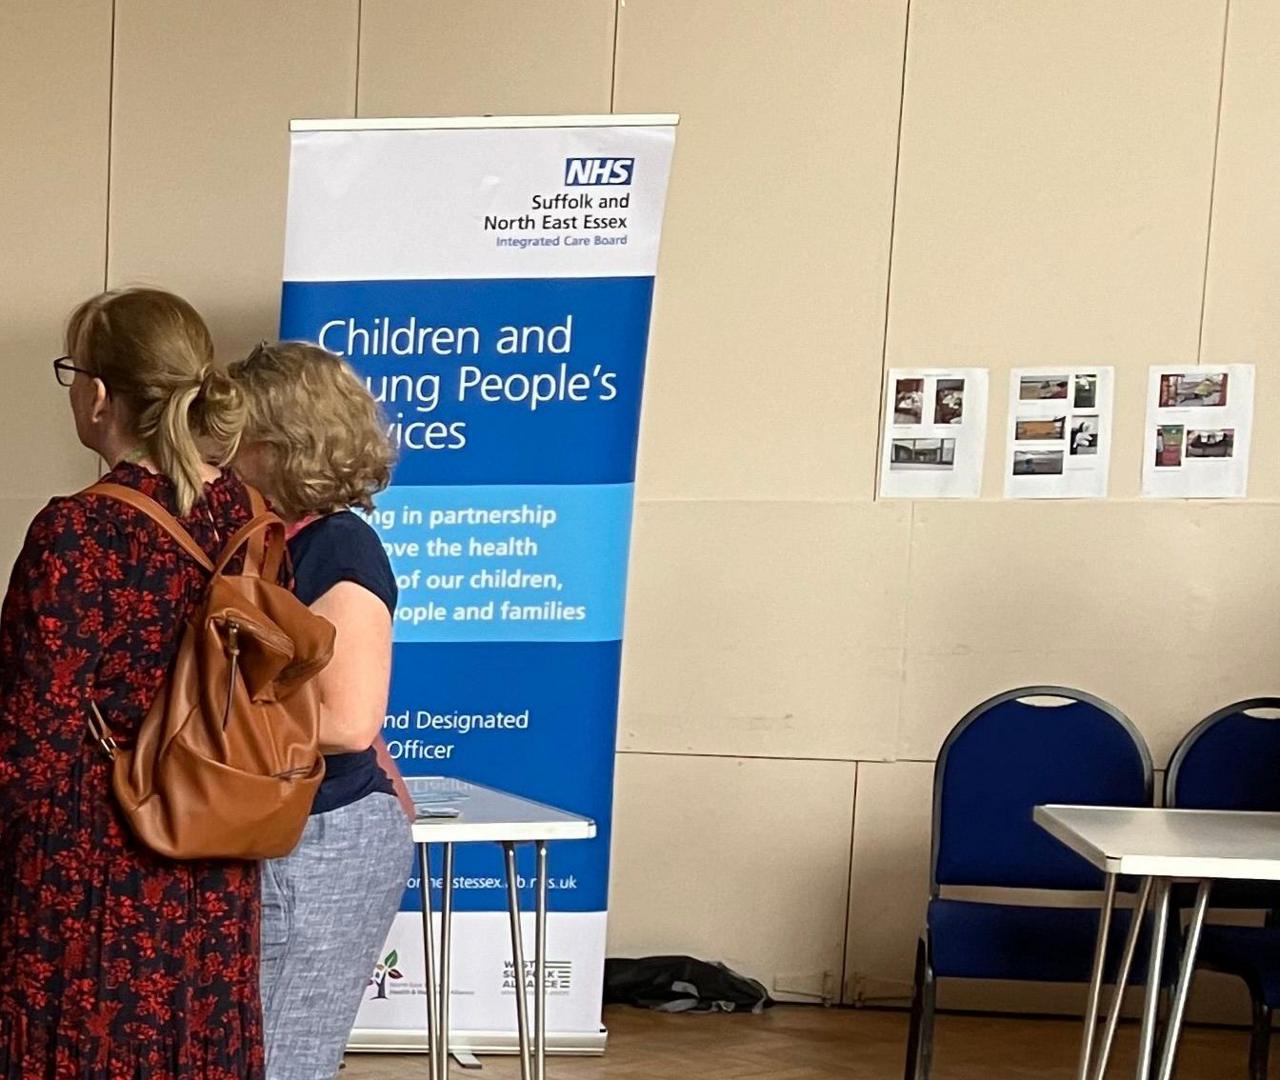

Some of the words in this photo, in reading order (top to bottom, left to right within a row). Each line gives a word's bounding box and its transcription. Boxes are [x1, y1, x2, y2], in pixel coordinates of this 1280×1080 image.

[567, 160, 633, 185] NHS
[532, 194, 593, 210] Suffolk
[599, 193, 629, 208] and
[485, 215, 535, 230] North
[543, 215, 577, 229] East
[584, 215, 627, 229] Essex
[497, 236, 560, 249] Integrated
[564, 236, 590, 246] Care
[594, 235, 627, 245] Board
[316, 317, 479, 356] Children
[497, 315, 572, 354] and
[367, 372, 440, 412] ung
[459, 363, 616, 410] People's
[390, 414, 467, 450] ices
[403, 506, 422, 524] in
[430, 505, 556, 529] partnership
[426, 538, 462, 556] the
[469, 537, 537, 556] health
[394, 570, 421, 591] of
[426, 575, 464, 589] our
[470, 569, 562, 590] children,
[393, 603, 446, 626] eople
[453, 601, 493, 620] and
[500, 601, 585, 620] families
[383, 712, 409, 730] nd
[417, 710, 528, 733] Designated
[387, 741, 454, 759] Officer
